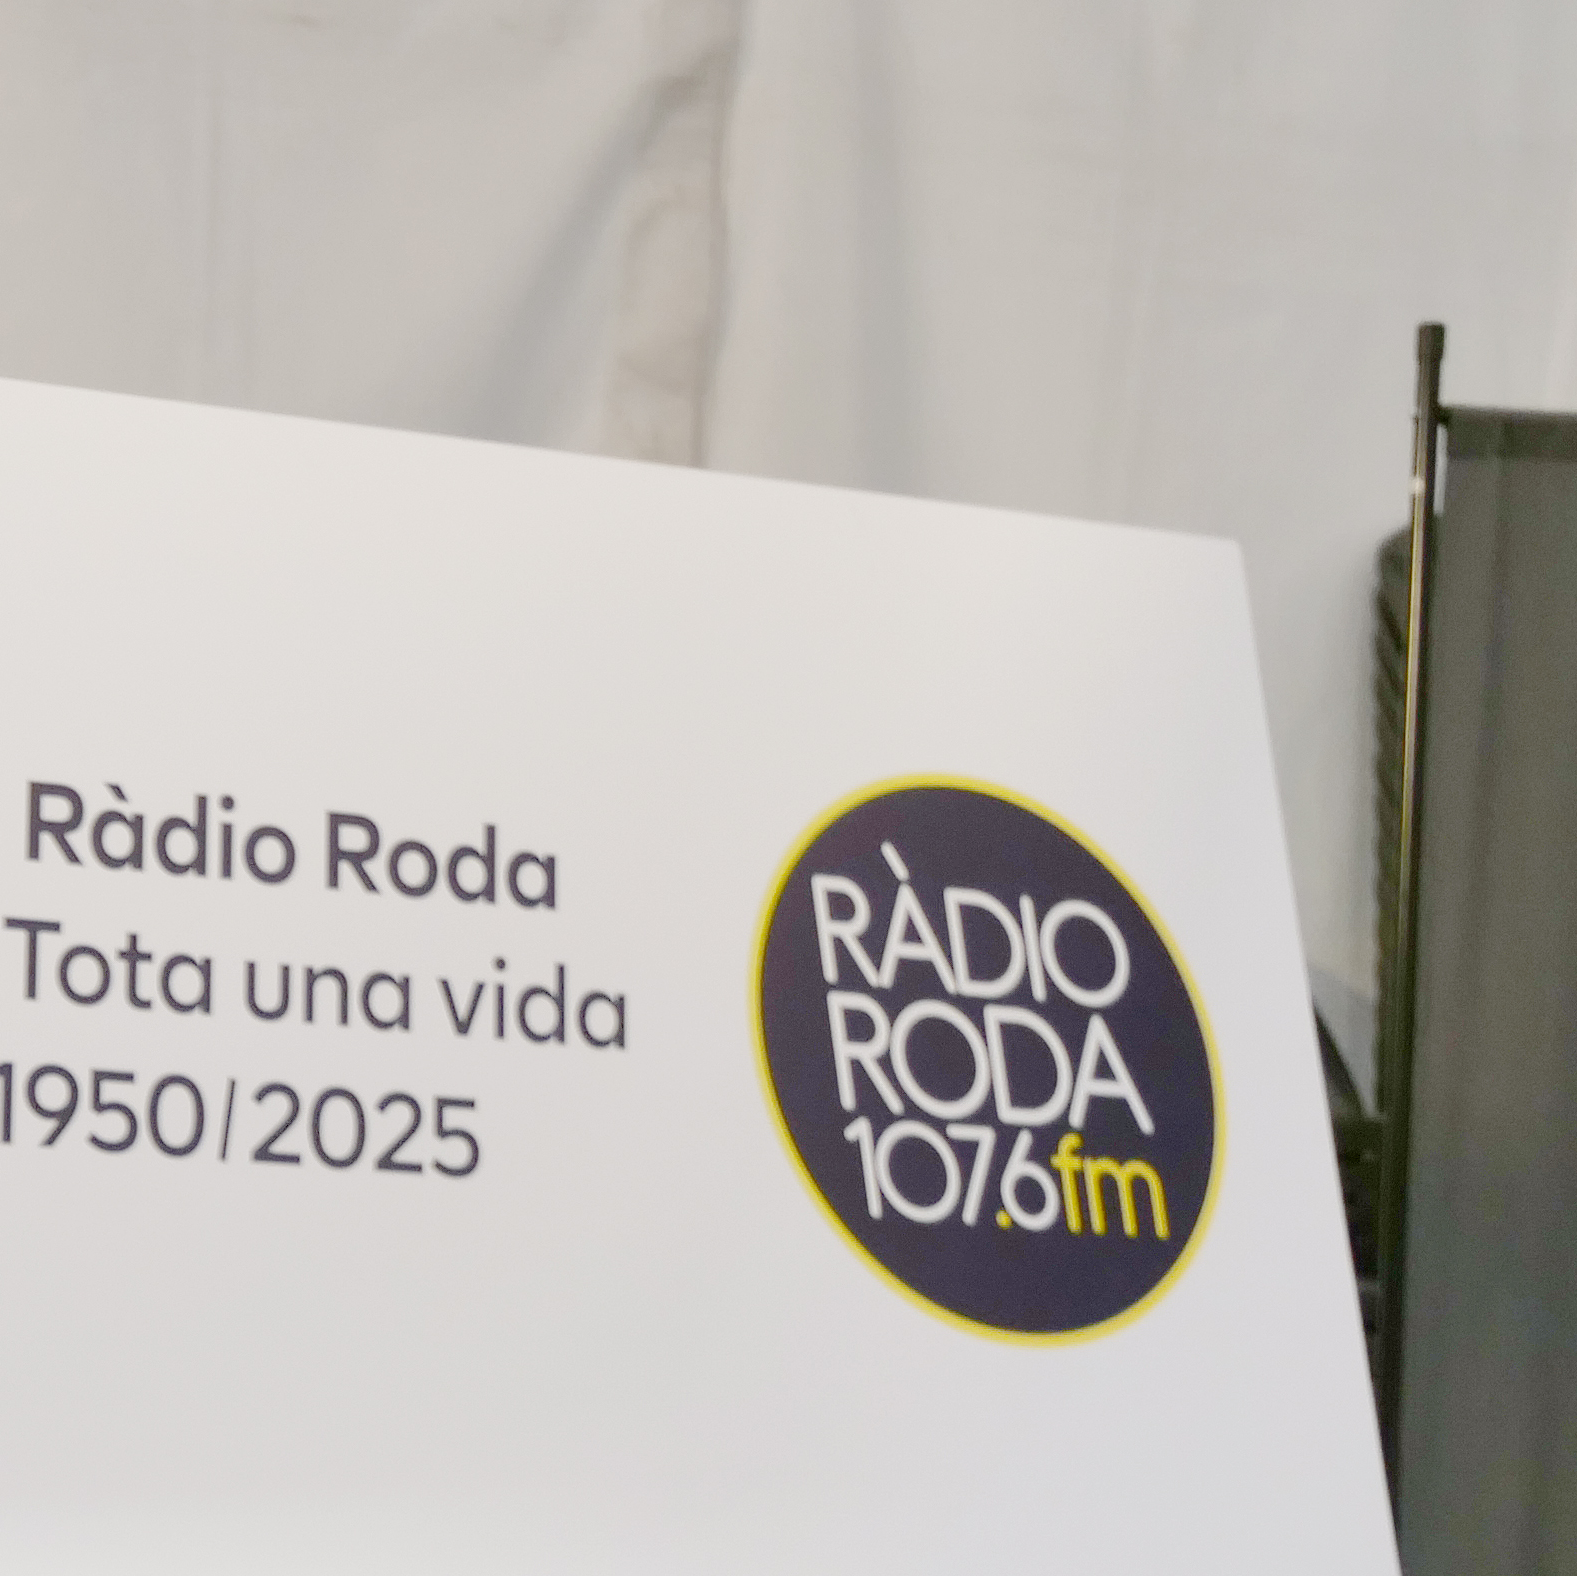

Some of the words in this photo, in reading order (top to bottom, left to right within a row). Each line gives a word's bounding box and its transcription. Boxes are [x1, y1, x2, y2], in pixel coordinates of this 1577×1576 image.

[27, 780, 297, 886] Ràdio
[326, 810, 557, 911] Roda
[3, 916, 213, 1016] Tota
[245, 960, 412, 1032] una
[438, 956, 627, 1051] vida
[810, 841, 1132, 1009] RÀDIO
[826, 989, 1156, 1136] RODA
